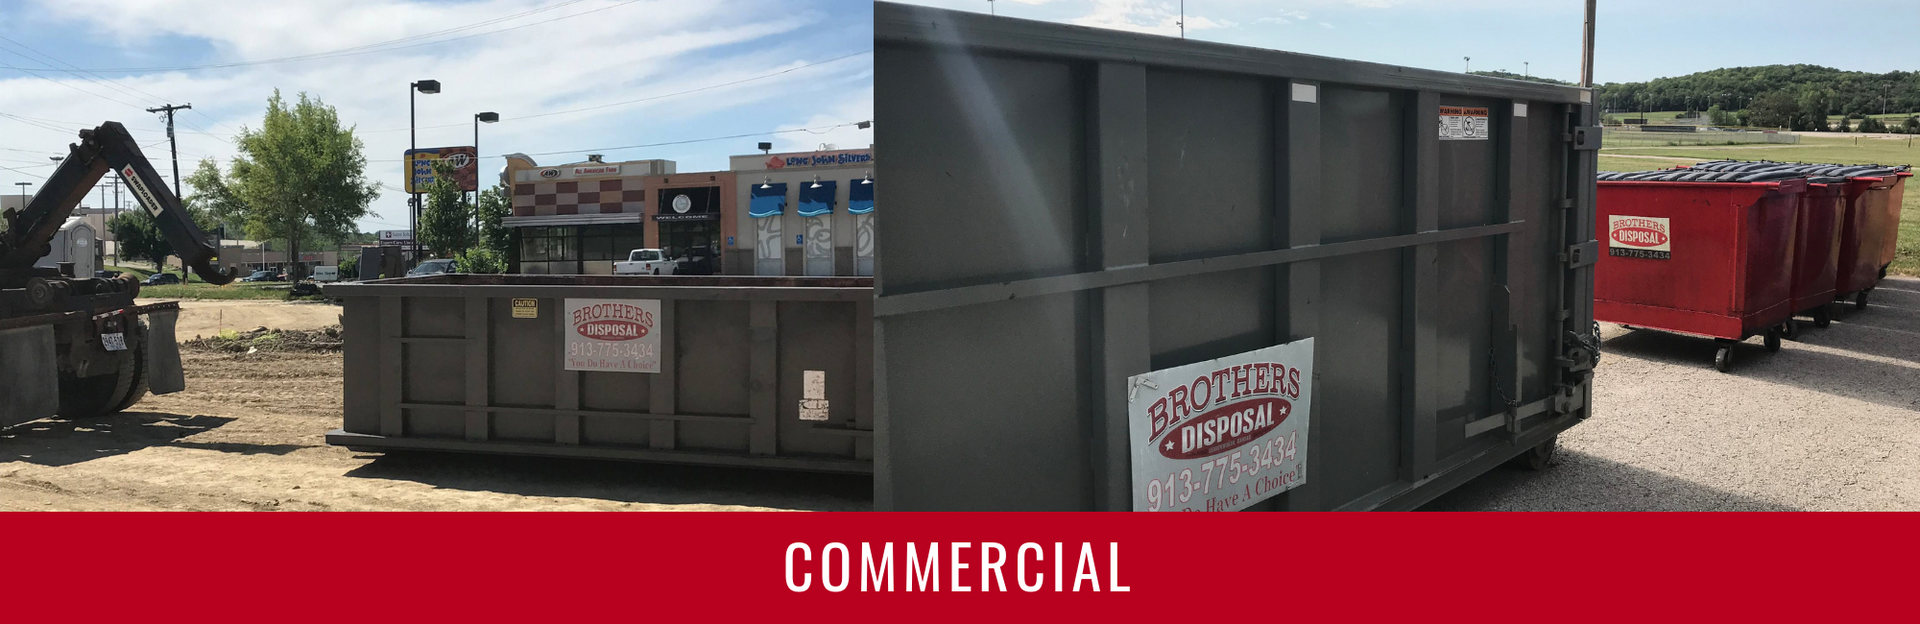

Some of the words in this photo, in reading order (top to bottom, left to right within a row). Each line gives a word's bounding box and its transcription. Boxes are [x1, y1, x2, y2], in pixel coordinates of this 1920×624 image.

[786, 157, 808, 166] LONG
[812, 155, 835, 167] JOHN
[131, 176, 159, 211] SWAPLOADER
[1613, 218, 1666, 233] BROTHERS
[1619, 230, 1660, 244] DISPOSAL
[1610, 248, 1671, 259] 913-775-3434
[572, 303, 653, 328] BROTHERS
[587, 323, 638, 336] DISPOSAL
[571, 341, 654, 358] 913-775-3434
[600, 360, 619, 368] Have
[1147, 362, 1301, 445] BROTHERS
[1181, 401, 1275, 453] DISPOSAL
[1147, 430, 1298, 512] 913-775-3434
[1206, 493, 1239, 512] Have
[1242, 485, 1251, 502] A
